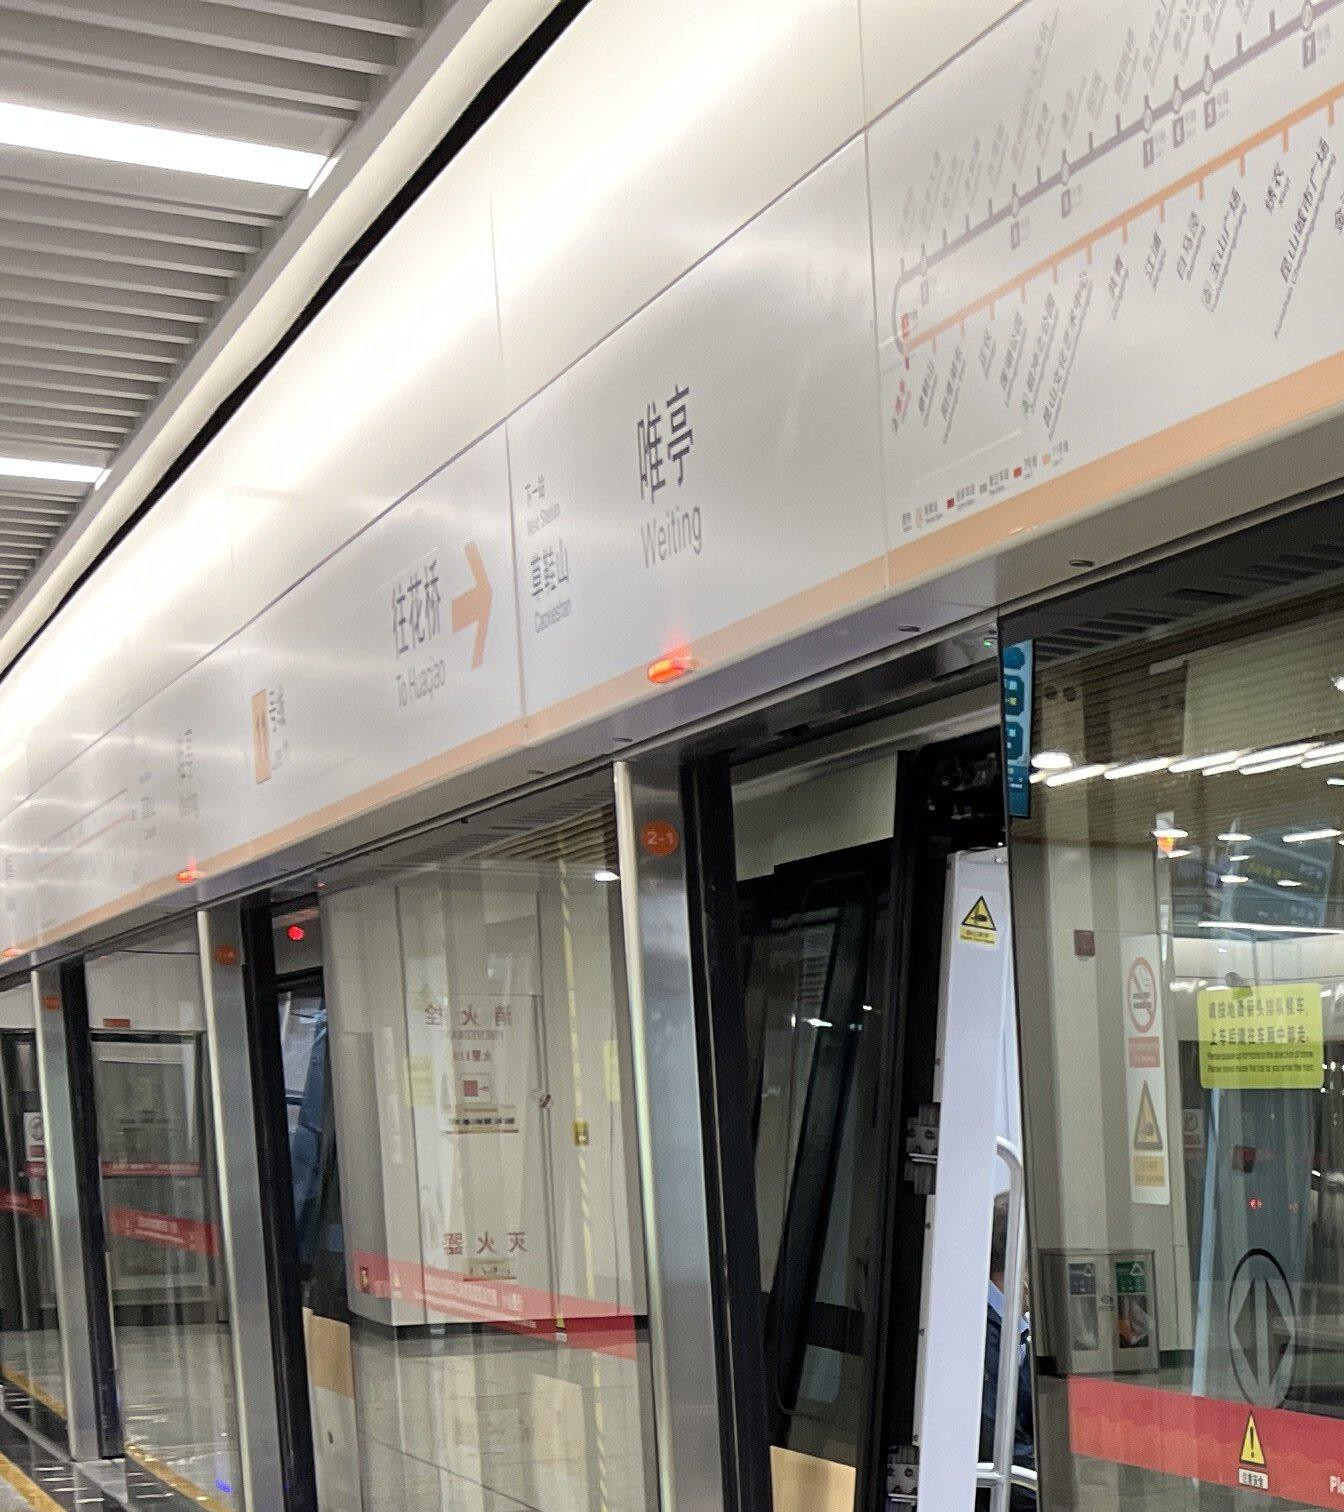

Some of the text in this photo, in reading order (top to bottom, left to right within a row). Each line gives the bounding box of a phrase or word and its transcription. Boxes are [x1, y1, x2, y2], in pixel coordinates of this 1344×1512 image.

[636, 384, 694, 503] 唯亭
[640, 506, 702, 569] Weiting
[392, 559, 442, 660] 往花桥
[648, 830, 674, 847] 2-1
